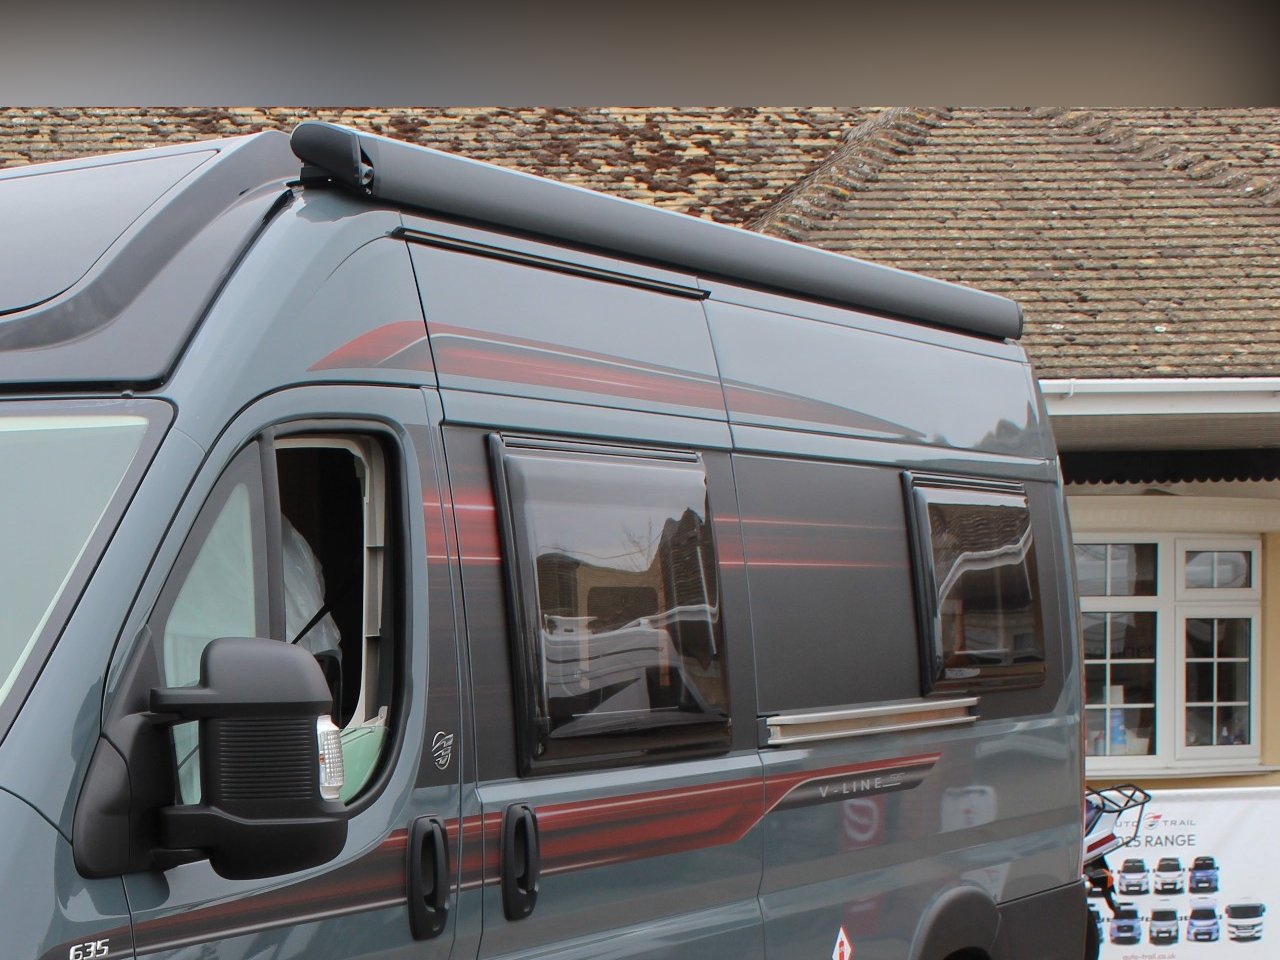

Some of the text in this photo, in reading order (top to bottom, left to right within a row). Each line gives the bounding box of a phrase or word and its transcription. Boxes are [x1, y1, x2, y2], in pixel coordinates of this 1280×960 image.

[819, 777, 882, 798] V-LINE
[1162, 819, 1196, 827] TRAIL
[1145, 834, 1196, 847] RANGE
